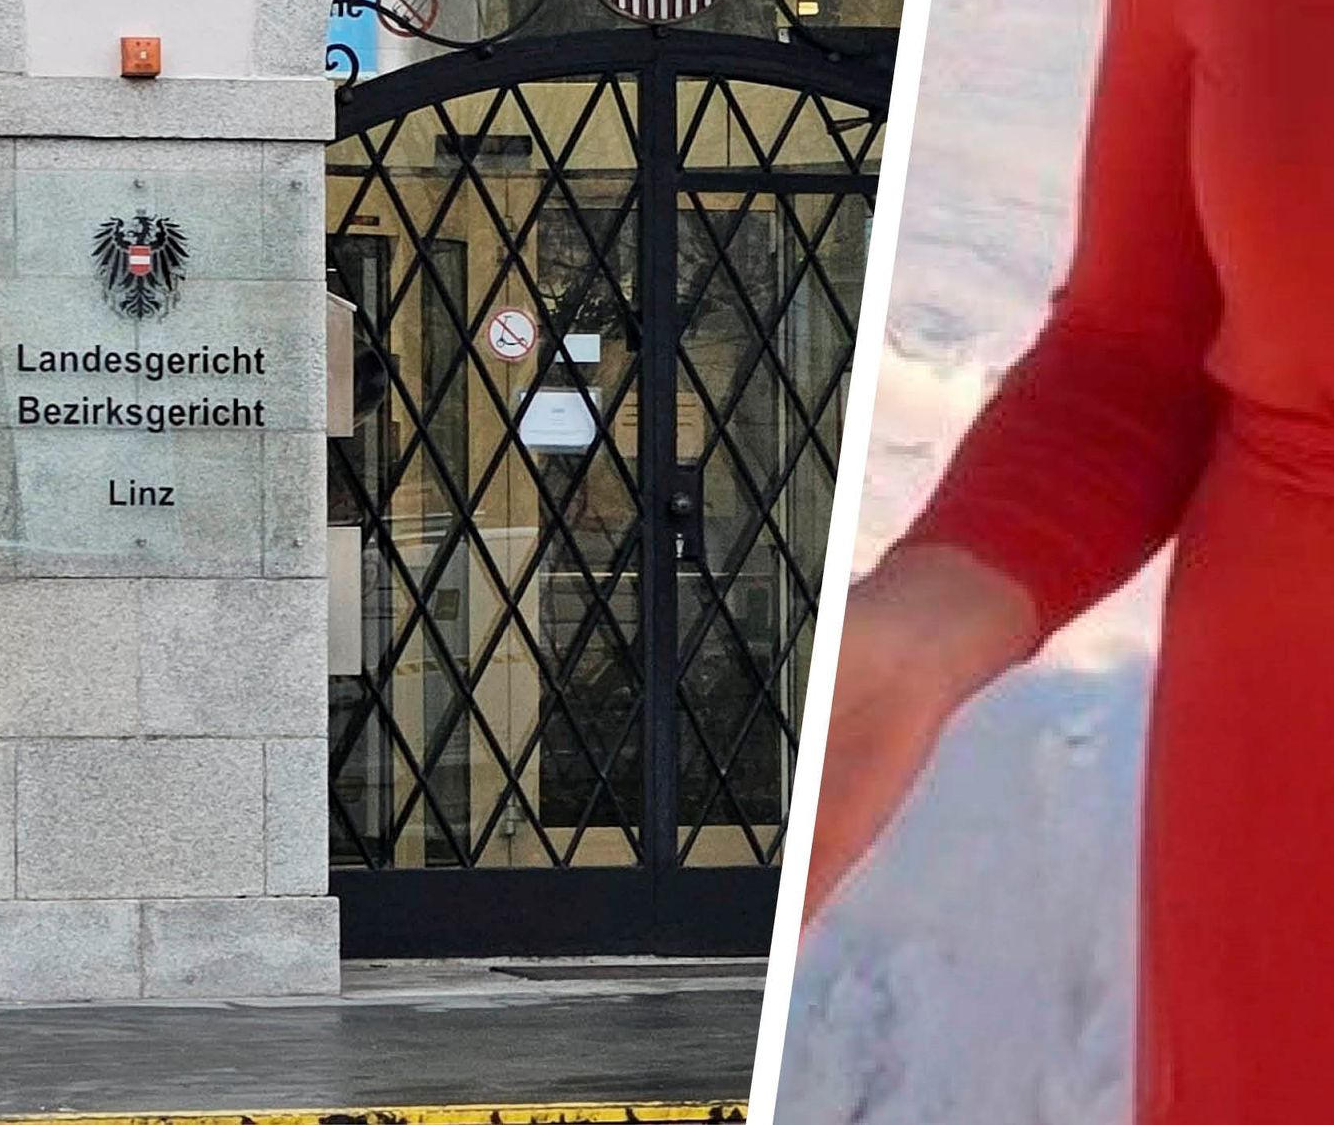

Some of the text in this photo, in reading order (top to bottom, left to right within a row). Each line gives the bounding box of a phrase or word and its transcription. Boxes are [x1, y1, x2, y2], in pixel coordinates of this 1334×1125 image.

[17, 343, 266, 382] Landesgericht
[17, 395, 266, 433] Bezirksgericht
[109, 479, 175, 507] Linz
